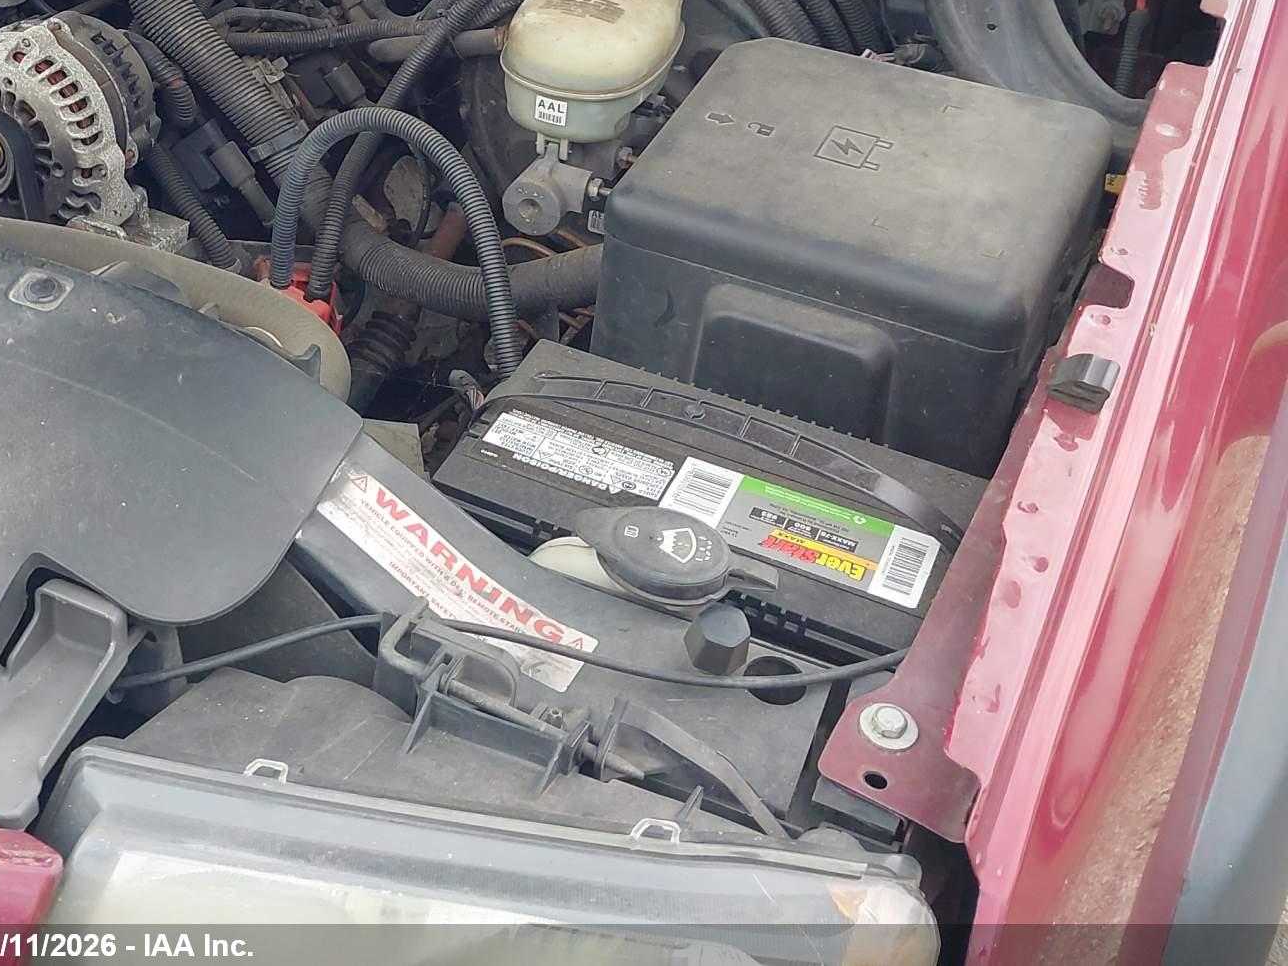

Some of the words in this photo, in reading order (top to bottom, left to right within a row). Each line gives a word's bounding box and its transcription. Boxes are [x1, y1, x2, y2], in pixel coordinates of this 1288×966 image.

[538, 101, 565, 114] AAL
[512, 453, 608, 491] DANGER/POISON
[777, 532, 806, 545] MAXX
[375, 487, 566, 645] WARNING
[760, 535, 866, 581] EverStart
